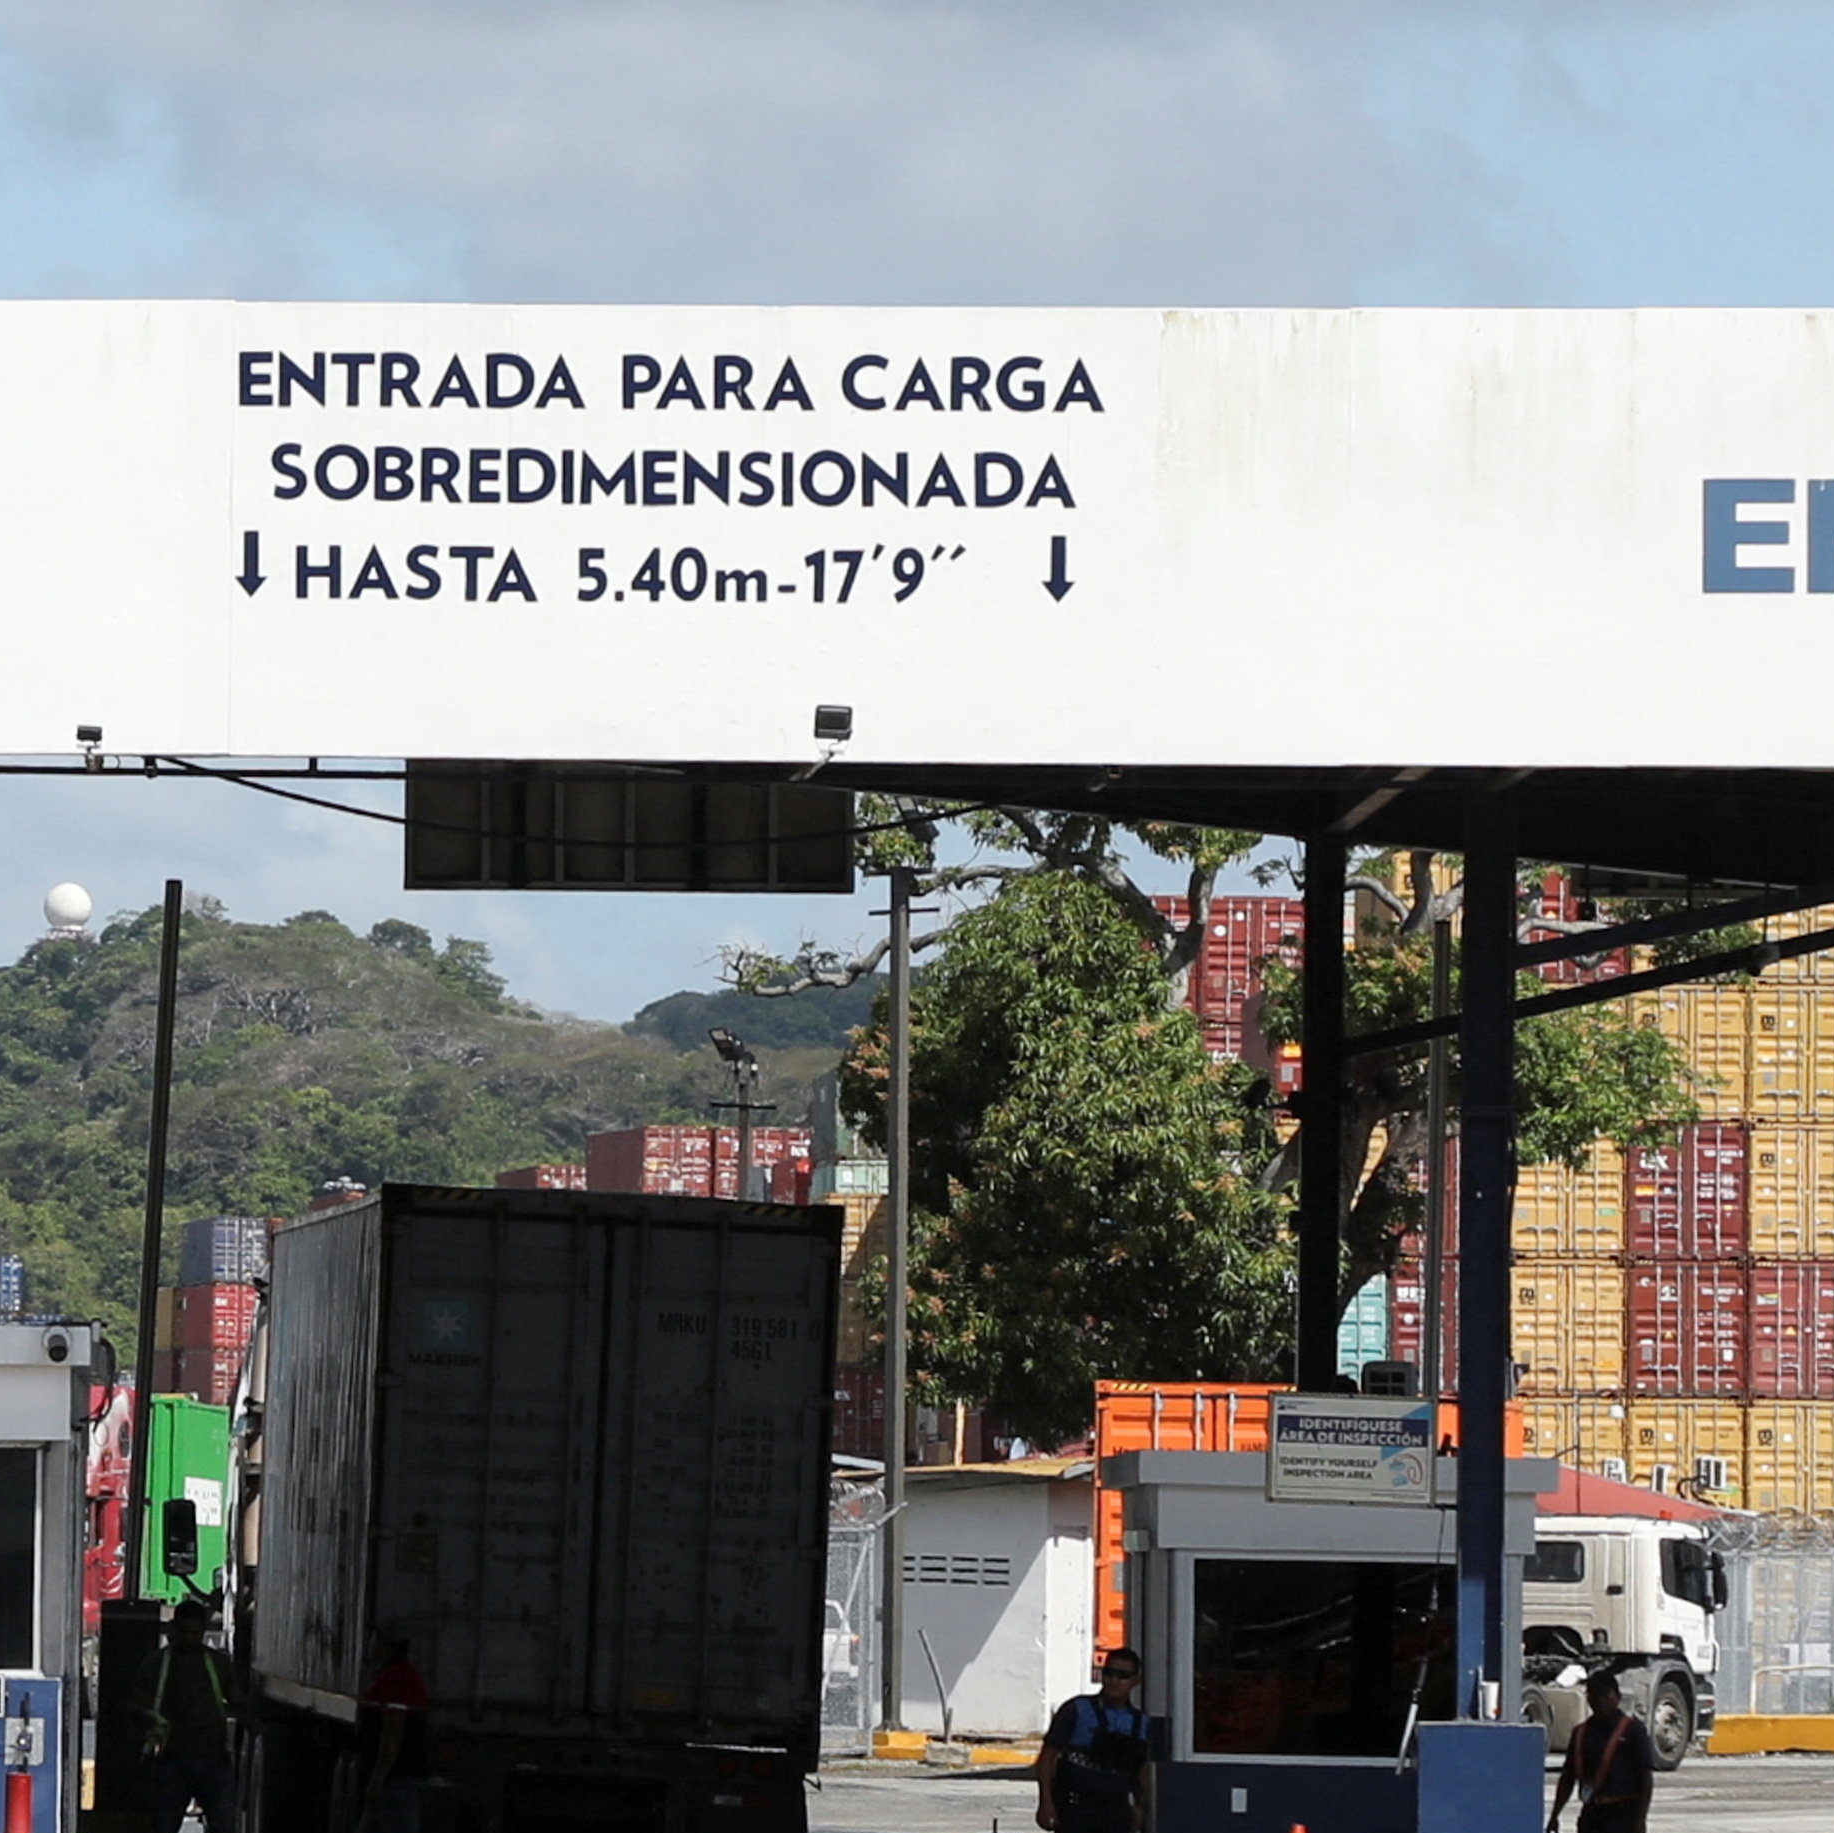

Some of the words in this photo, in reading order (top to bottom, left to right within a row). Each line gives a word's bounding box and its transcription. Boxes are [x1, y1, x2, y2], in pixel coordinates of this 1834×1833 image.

[238, 351, 586, 410] ENTRADA
[621, 354, 815, 412] PARA
[841, 354, 1105, 413] CARGA
[270, 442, 1076, 509] SOBREDIMENSIONADA
[295, 544, 538, 603] HASTA
[657, 1312, 707, 1334] MRKU
[730, 1317, 761, 1337] 319
[408, 1353, 482, 1367] MAERSK
[1317, 1431, 1335, 1443] DE
[1338, 1431, 1423, 1446] INSPECCIÓN
[1346, 1471, 1373, 1480] AREA
